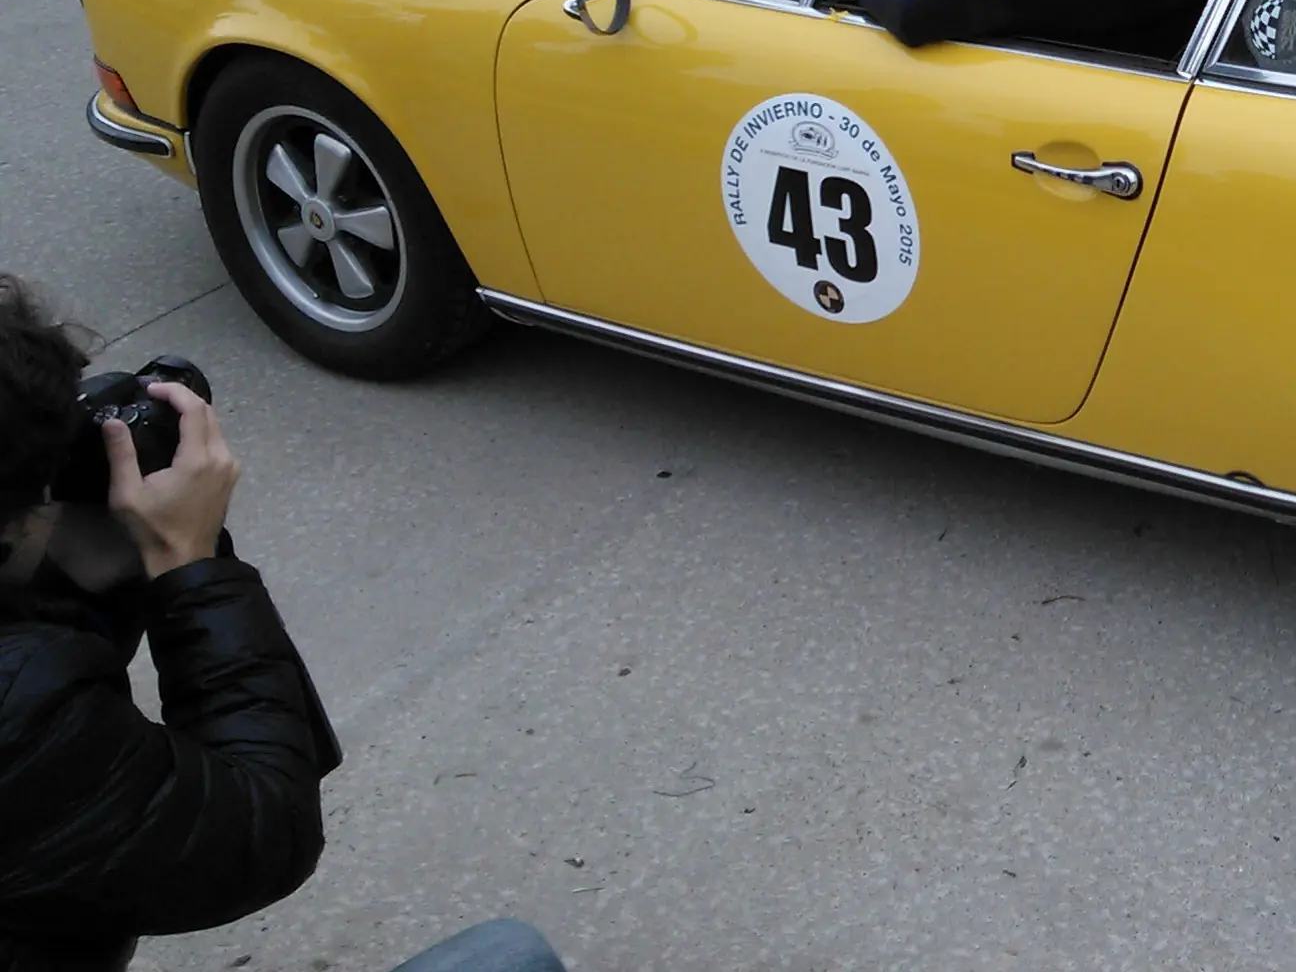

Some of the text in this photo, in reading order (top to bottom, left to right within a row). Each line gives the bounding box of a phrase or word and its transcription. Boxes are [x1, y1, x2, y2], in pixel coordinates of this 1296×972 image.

[743, 100, 823, 140] INVIERNO
[839, 116, 861, 139] 30
[730, 135, 749, 164] DE
[861, 139, 881, 163] de
[726, 165, 747, 226] RALLY
[880, 164, 907, 218] Mayo
[767, 165, 879, 284] 43
[899, 223, 914, 267] 2015
